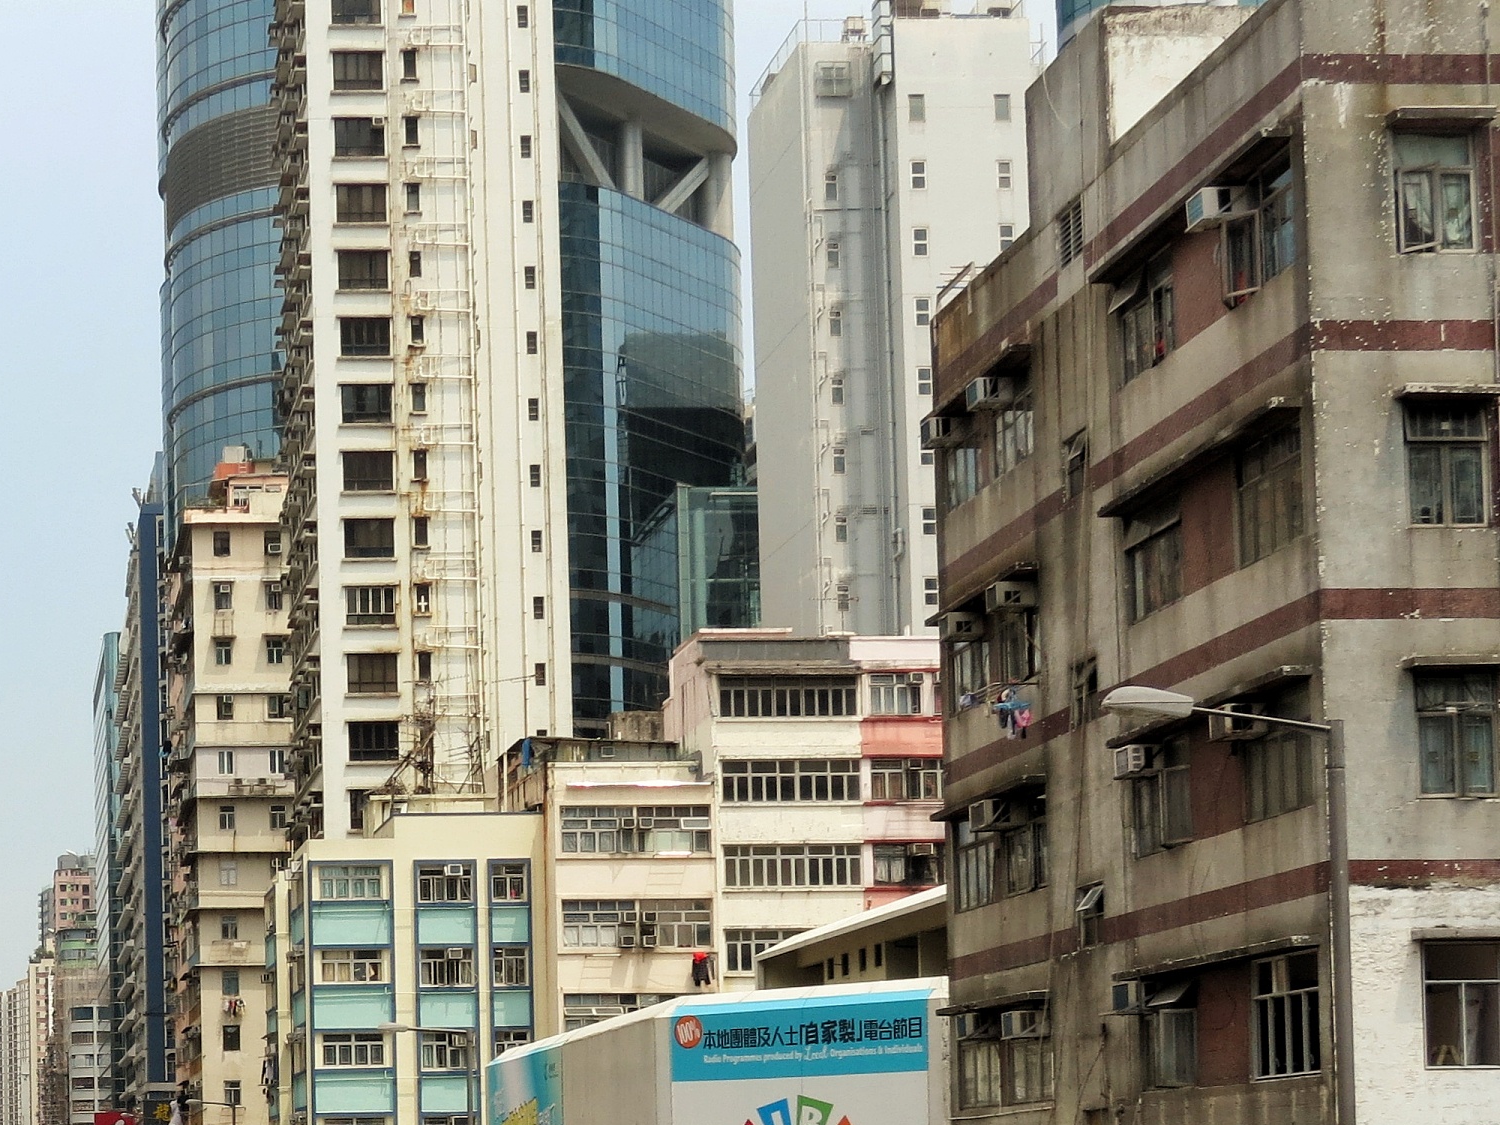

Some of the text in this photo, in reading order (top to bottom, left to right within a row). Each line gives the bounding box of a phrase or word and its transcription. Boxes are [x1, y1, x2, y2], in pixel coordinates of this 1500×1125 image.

[677, 1019, 701, 1046] 100%
[703, 1055, 722, 1064] Radio
[722, 1053, 763, 1065] Programmes
[763, 1051, 792, 1063] produced
[793, 1051, 803, 1062] by
